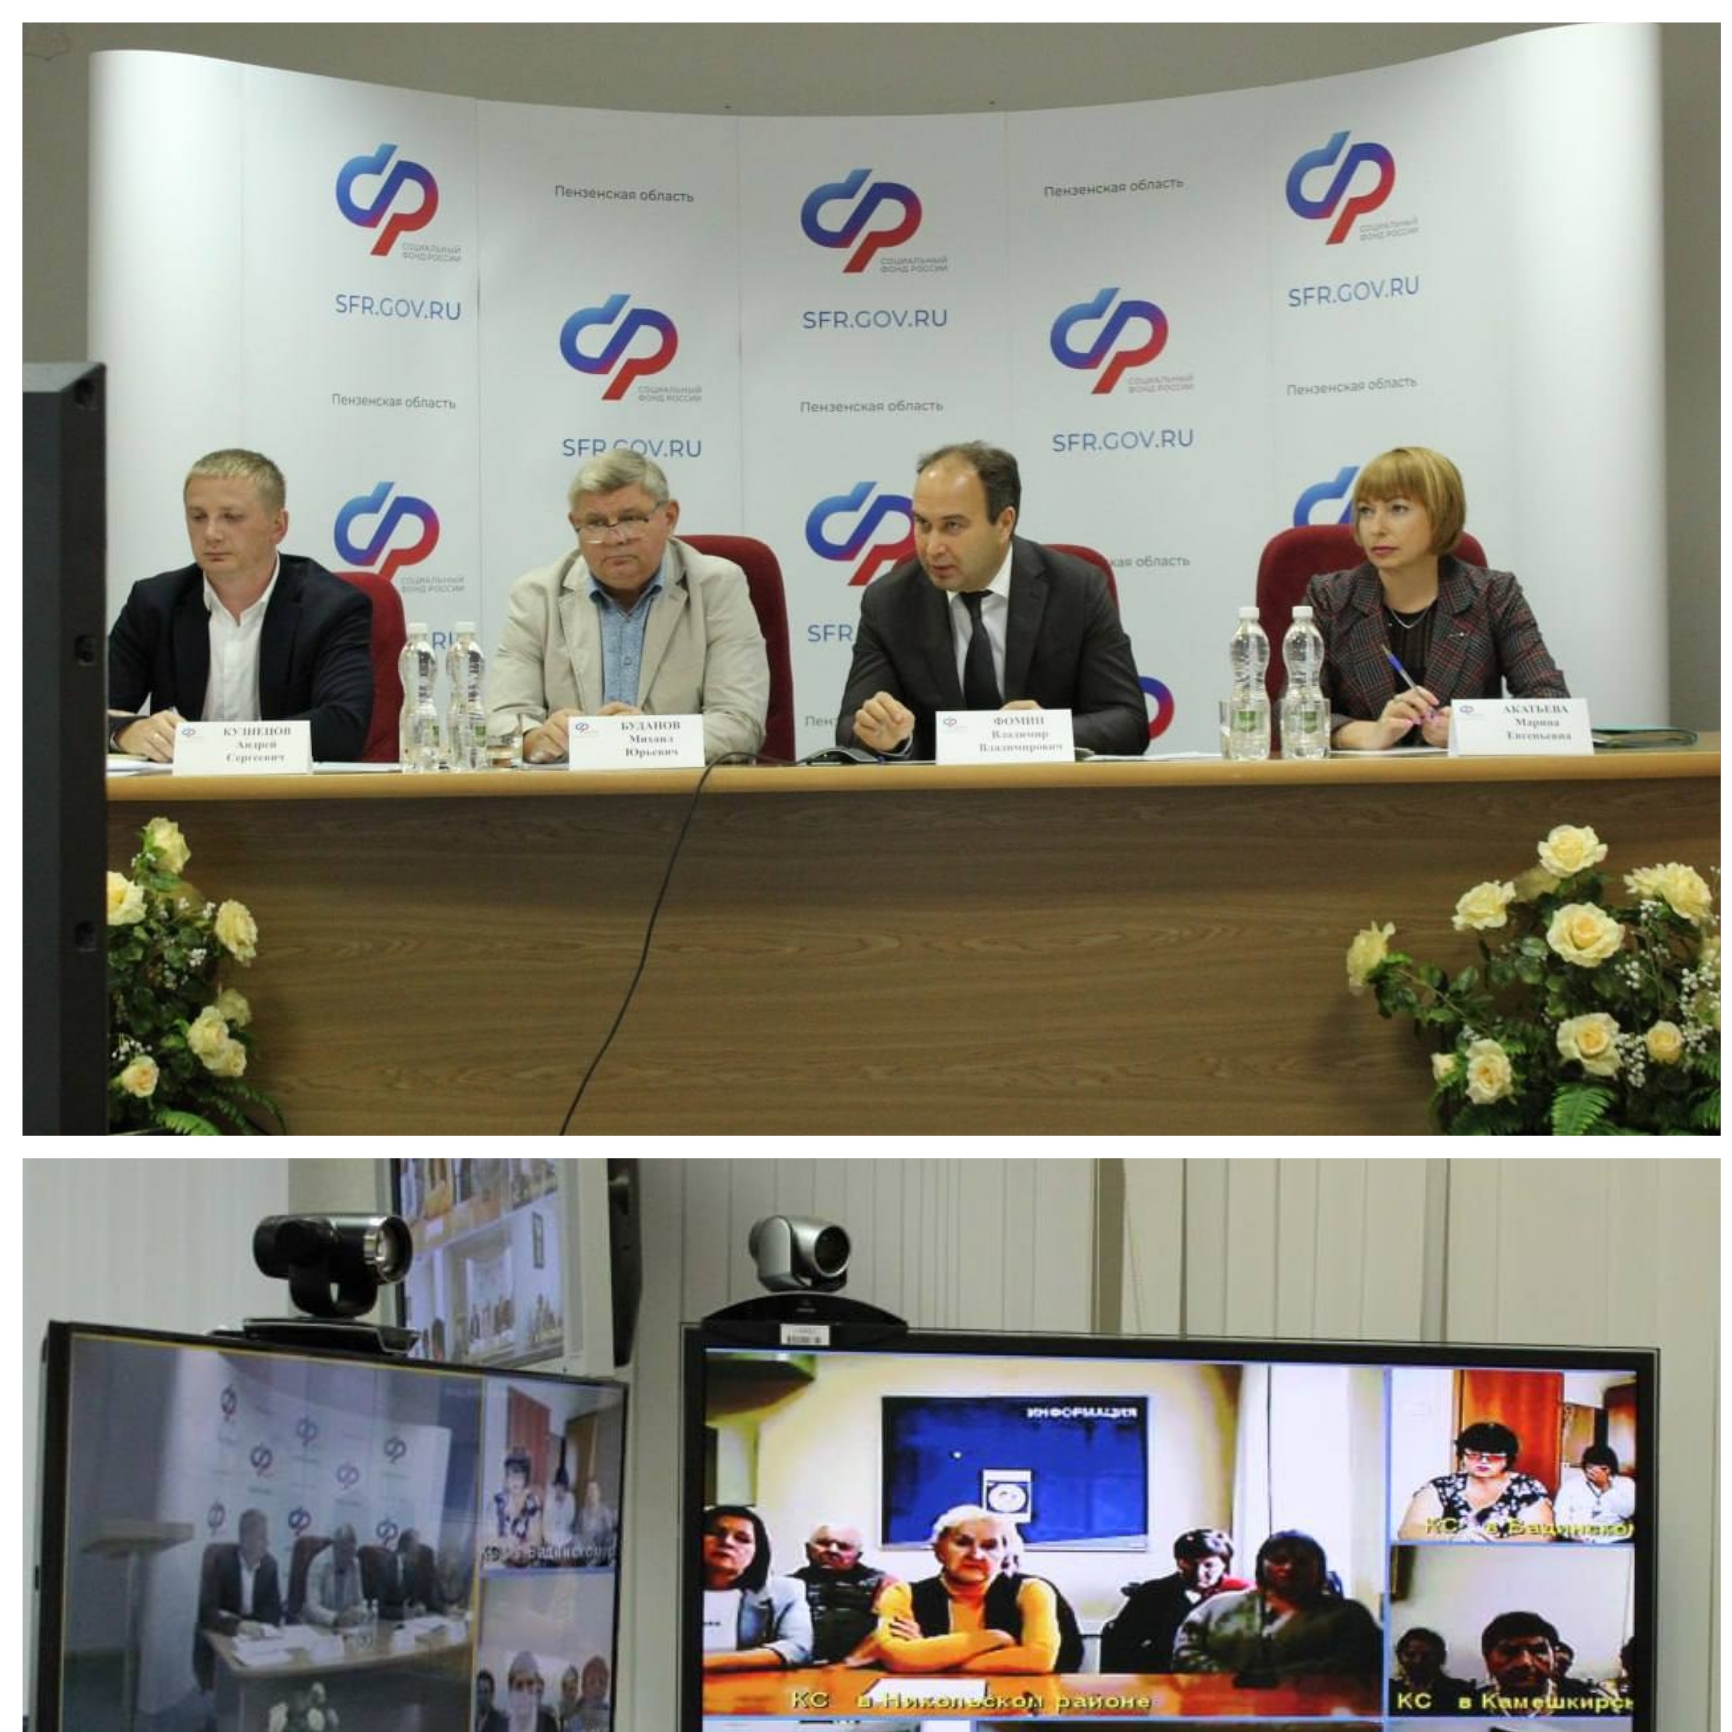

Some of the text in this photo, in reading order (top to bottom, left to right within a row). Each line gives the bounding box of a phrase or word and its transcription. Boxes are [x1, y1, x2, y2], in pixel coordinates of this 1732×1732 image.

[554, 185, 694, 203] Пензенская область
[1044, 177, 1184, 198] Пензенская область
[1288, 276, 1418, 307] SFR.GOV.RU
[336, 294, 461, 320] SFR.GOV.RU
[803, 309, 947, 329] SFR.GOV.RU
[1286, 377, 1418, 396] Пензенская область
[332, 393, 457, 410] Пензенская область
[800, 399, 944, 414] Пензенская область
[562, 438, 702, 457] SFROV.RU
[1052, 428, 1194, 452] SFR.GOV.RU
[1135, 555, 1190, 567] область
[794, 1692, 1152, 1713] КС в Никольском районе
[1397, 1692, 1432, 1709] КС
[1458, 1696, 1472, 1709] в
